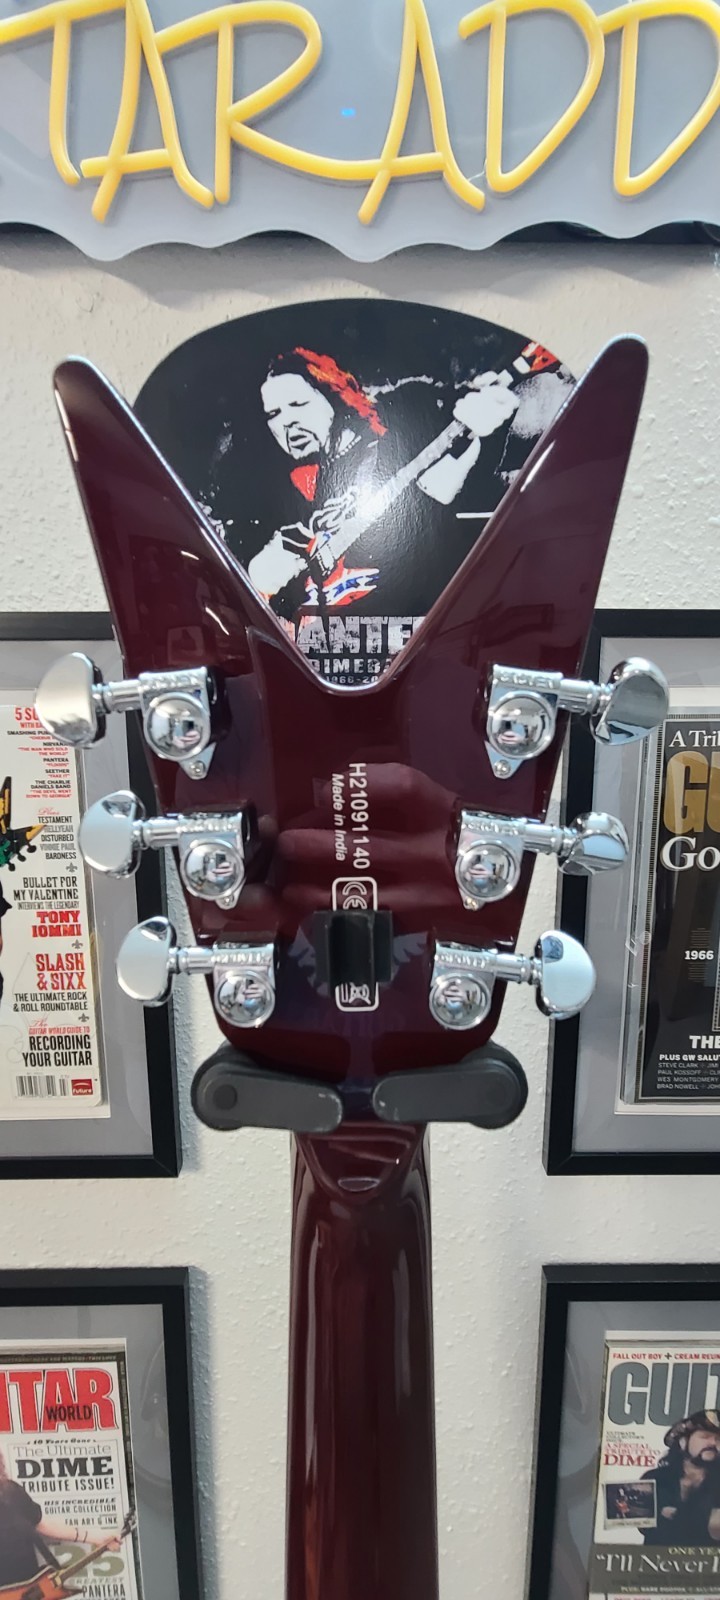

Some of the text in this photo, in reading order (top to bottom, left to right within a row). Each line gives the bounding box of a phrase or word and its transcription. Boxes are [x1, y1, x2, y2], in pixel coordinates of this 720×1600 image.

[15, 707, 22, 721] 5
[669, 730, 686, 748] A
[332, 773, 347, 861] Made in India
[349, 763, 370, 869] H21091140
[41, 834, 75, 842] DISTURBED
[45, 852, 77, 860] BARONESS
[23, 876, 78, 888] BULLET FOR
[14, 889, 79, 901] MY VALENTINE
[36, 911, 80, 923] TONY
[32, 924, 82, 937] IOMMI
[684, 950, 714, 960] 1966
[35, 953, 85, 972] SLASH
[37, 972, 87, 990] & SIXX
[15, 991, 88, 1002] THE ULTIMATE ROCK
[13, 1001, 88, 1012] & ROLL ROUNDTABLE
[29, 1034, 91, 1051] RECORDING
[689, 1035, 720, 1049] THE
[22, 1050, 92, 1067] YOUR GUITAR
[46, 1405, 92, 1421] WORLD
[14, 1444, 111, 1457] The Ultimate
[15, 1456, 113, 1478] DIME
[604, 1454, 656, 1467] DIME
[21, 1478, 114, 1493] TRIBUTE ISSUE!
[45, 1505, 116, 1515] GUITAR COLLECTION
[668, 1547, 696, 1555] ONE
[639, 1554, 708, 1573] Never
[82, 1584, 126, 1598] PANTERA
